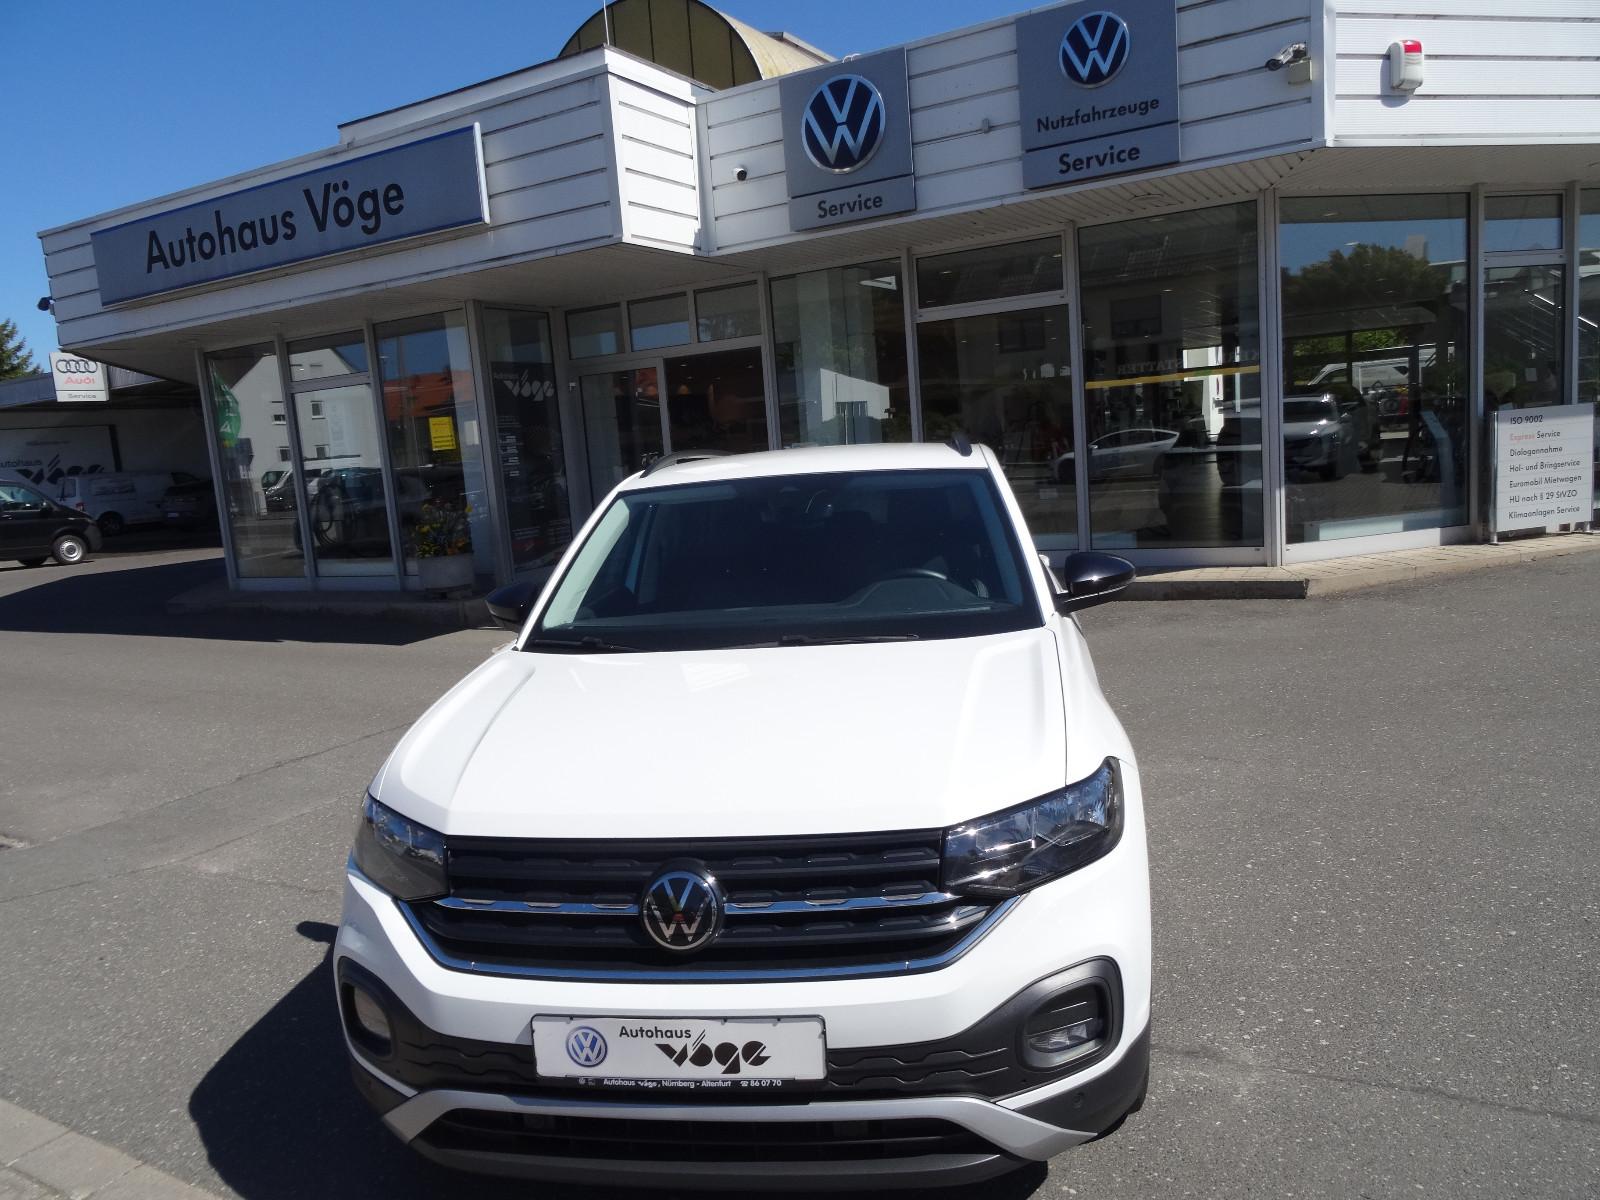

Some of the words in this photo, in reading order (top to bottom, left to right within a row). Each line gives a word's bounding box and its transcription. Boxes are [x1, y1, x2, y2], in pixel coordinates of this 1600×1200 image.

[1037, 98, 1160, 132] Nutzfahrzeuge
[1059, 145, 1141, 175] Service
[817, 194, 884, 219] Service
[146, 210, 297, 273] Autohaus
[303, 180, 405, 235] Vöge
[64, 376, 96, 385] Audi
[1510, 416, 1522, 425] ISO
[1525, 414, 1543, 424] 9002
[1537, 430, 1561, 439] Service
[1510, 445, 1563, 457] Dialogannahme
[1509, 464, 1524, 473] Hol-
[1526, 463, 1538, 471] und
[1540, 459, 1581, 470] Bringservice
[1509, 476, 1543, 488] Euromobil
[1544, 474, 1582, 485] Mietwagen
[1509, 496, 1520, 504] HU
[1521, 493, 1538, 503] nach
[1545, 492, 1554, 500] 29
[1508, 508, 1555, 519] Klimaanlagen
[1556, 505, 1581, 515] Service
[619, 1025, 692, 1039] Autohaus
[603, 1078, 636, 1087] Autohaus
[661, 1079, 695, 1089] Nürnberg
[701, 1079, 732, 1087] Altenfurt
